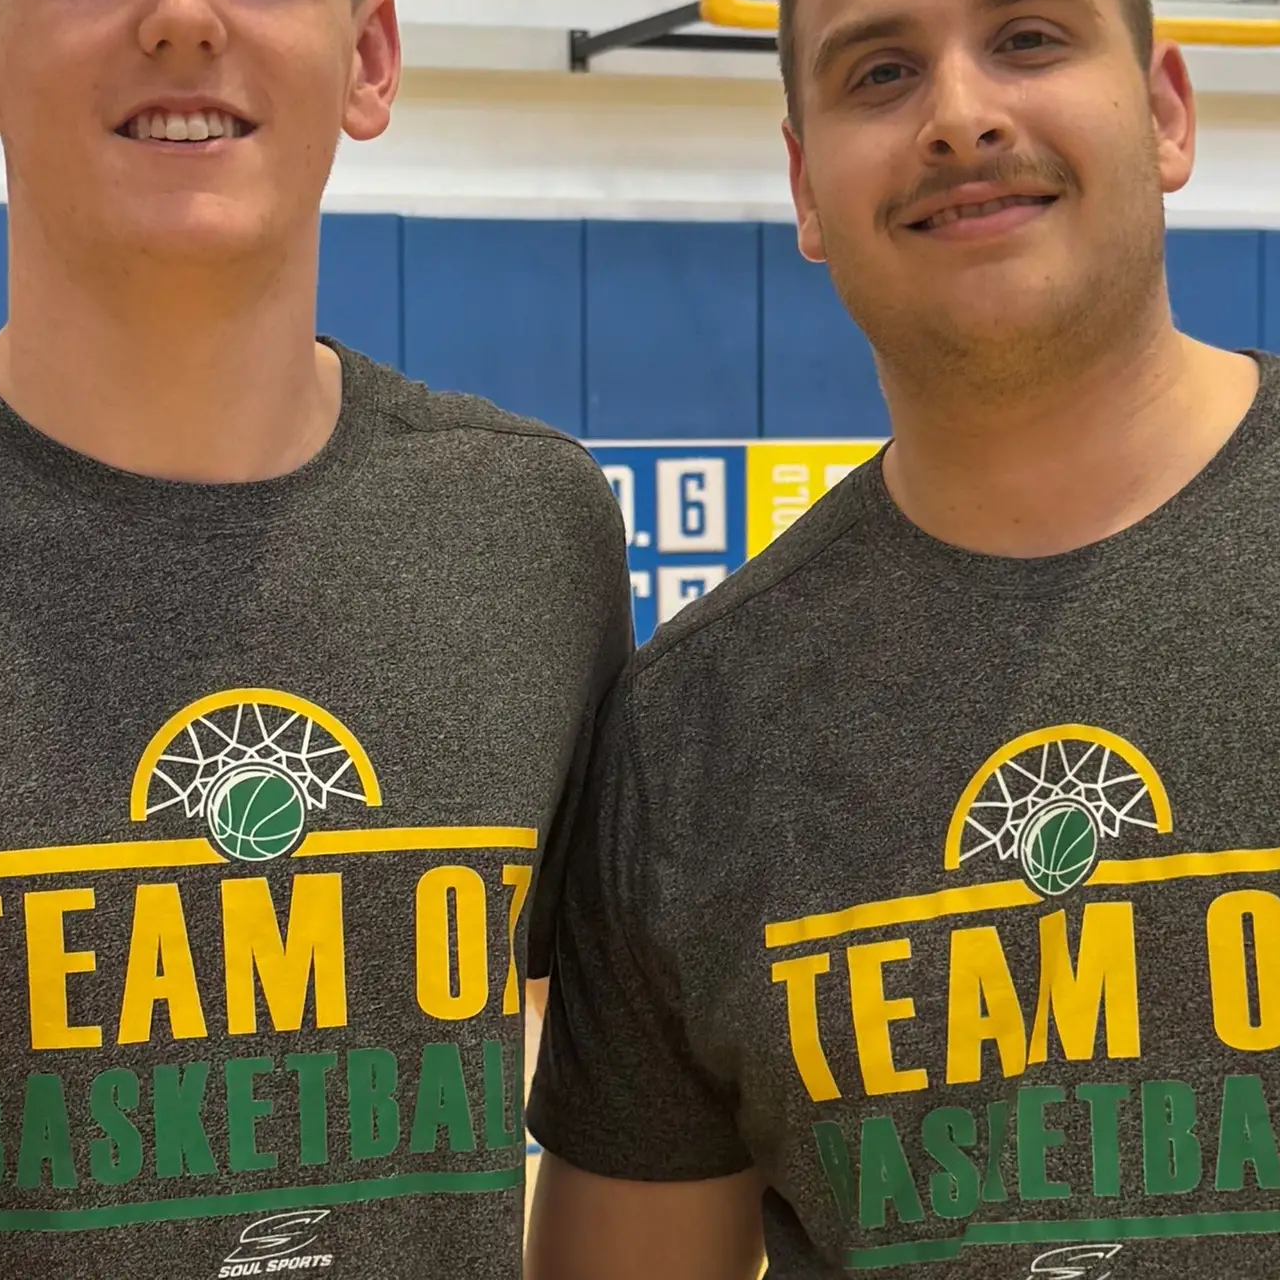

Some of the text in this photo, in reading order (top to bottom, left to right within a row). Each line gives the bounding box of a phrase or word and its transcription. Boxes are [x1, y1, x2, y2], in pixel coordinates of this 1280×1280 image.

[771, 902, 1141, 1102] TEAM
[218, 1254, 333, 1278] SOUL SPORTS
